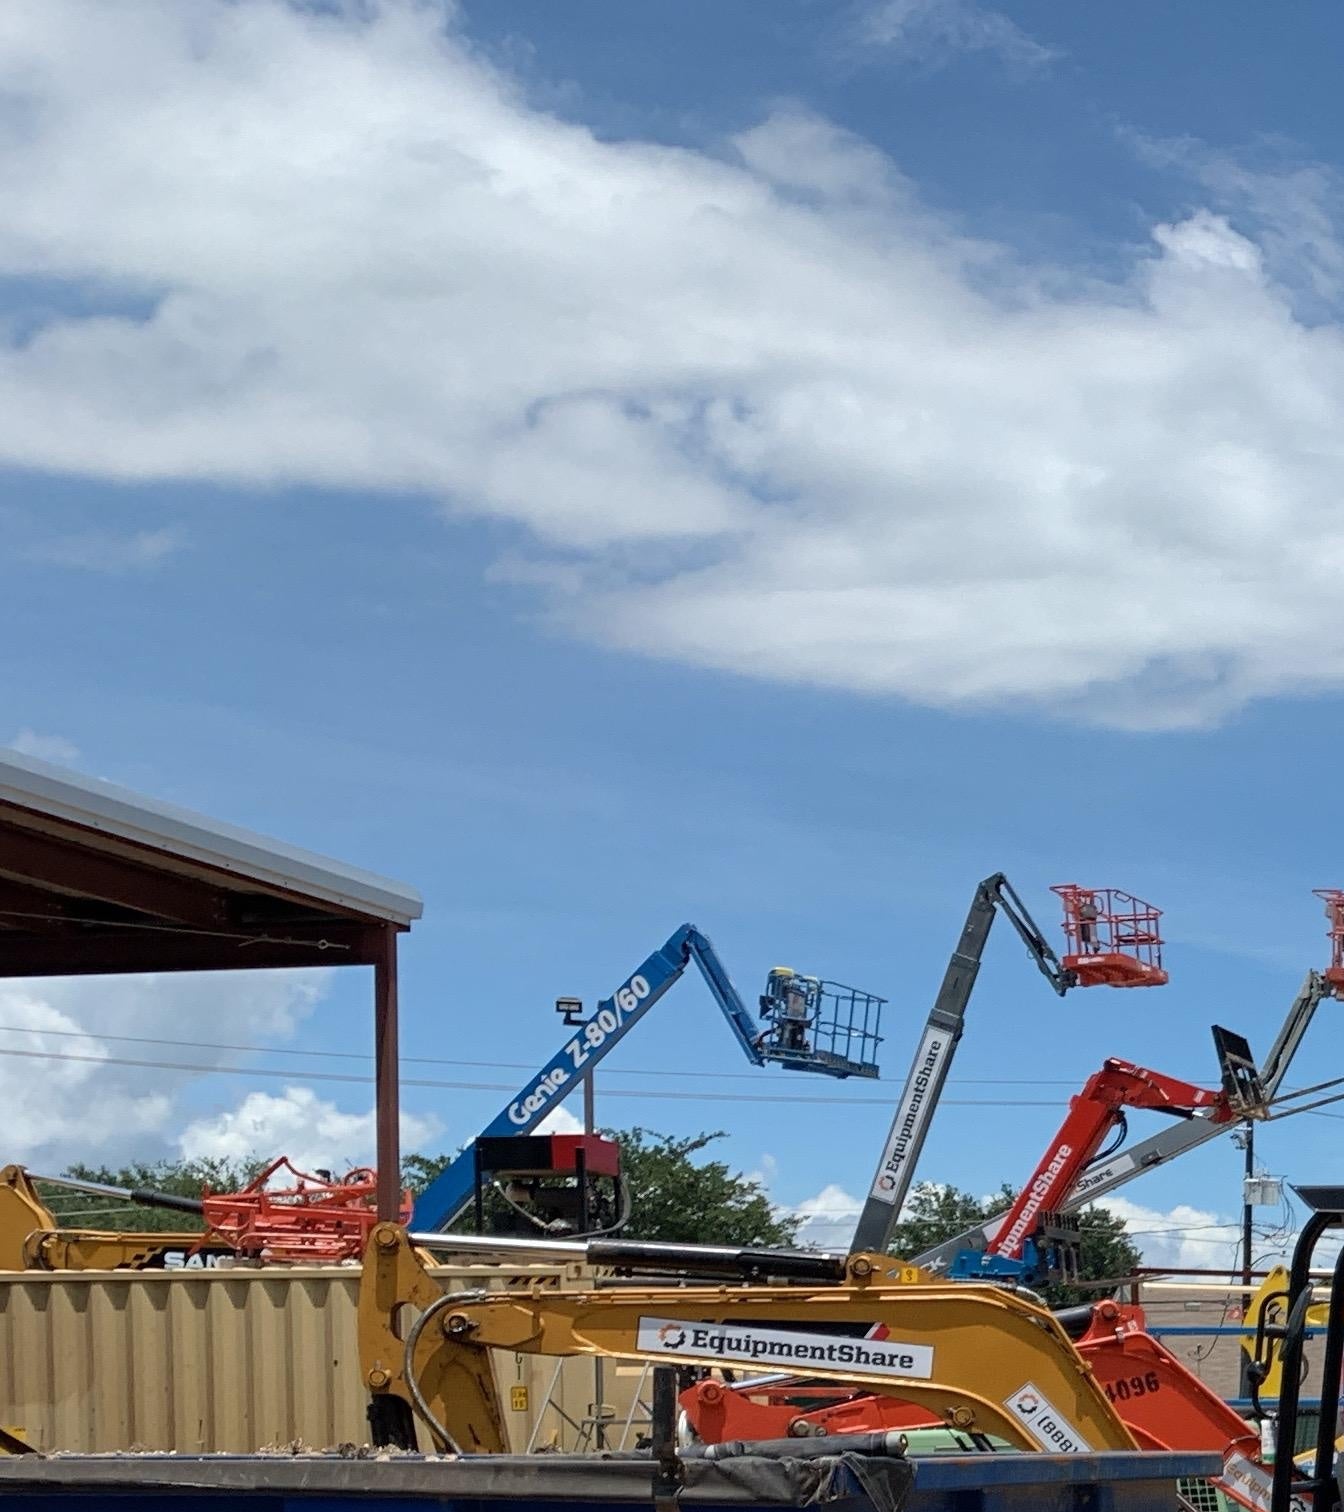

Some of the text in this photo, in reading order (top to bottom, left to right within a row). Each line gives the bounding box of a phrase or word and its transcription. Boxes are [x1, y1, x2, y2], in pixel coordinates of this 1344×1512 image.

[508, 975, 650, 1125] Genie Z-80/60
[885, 1040, 941, 1174] EquipmentShare
[692, 1328, 914, 1369] EquipmentShare
